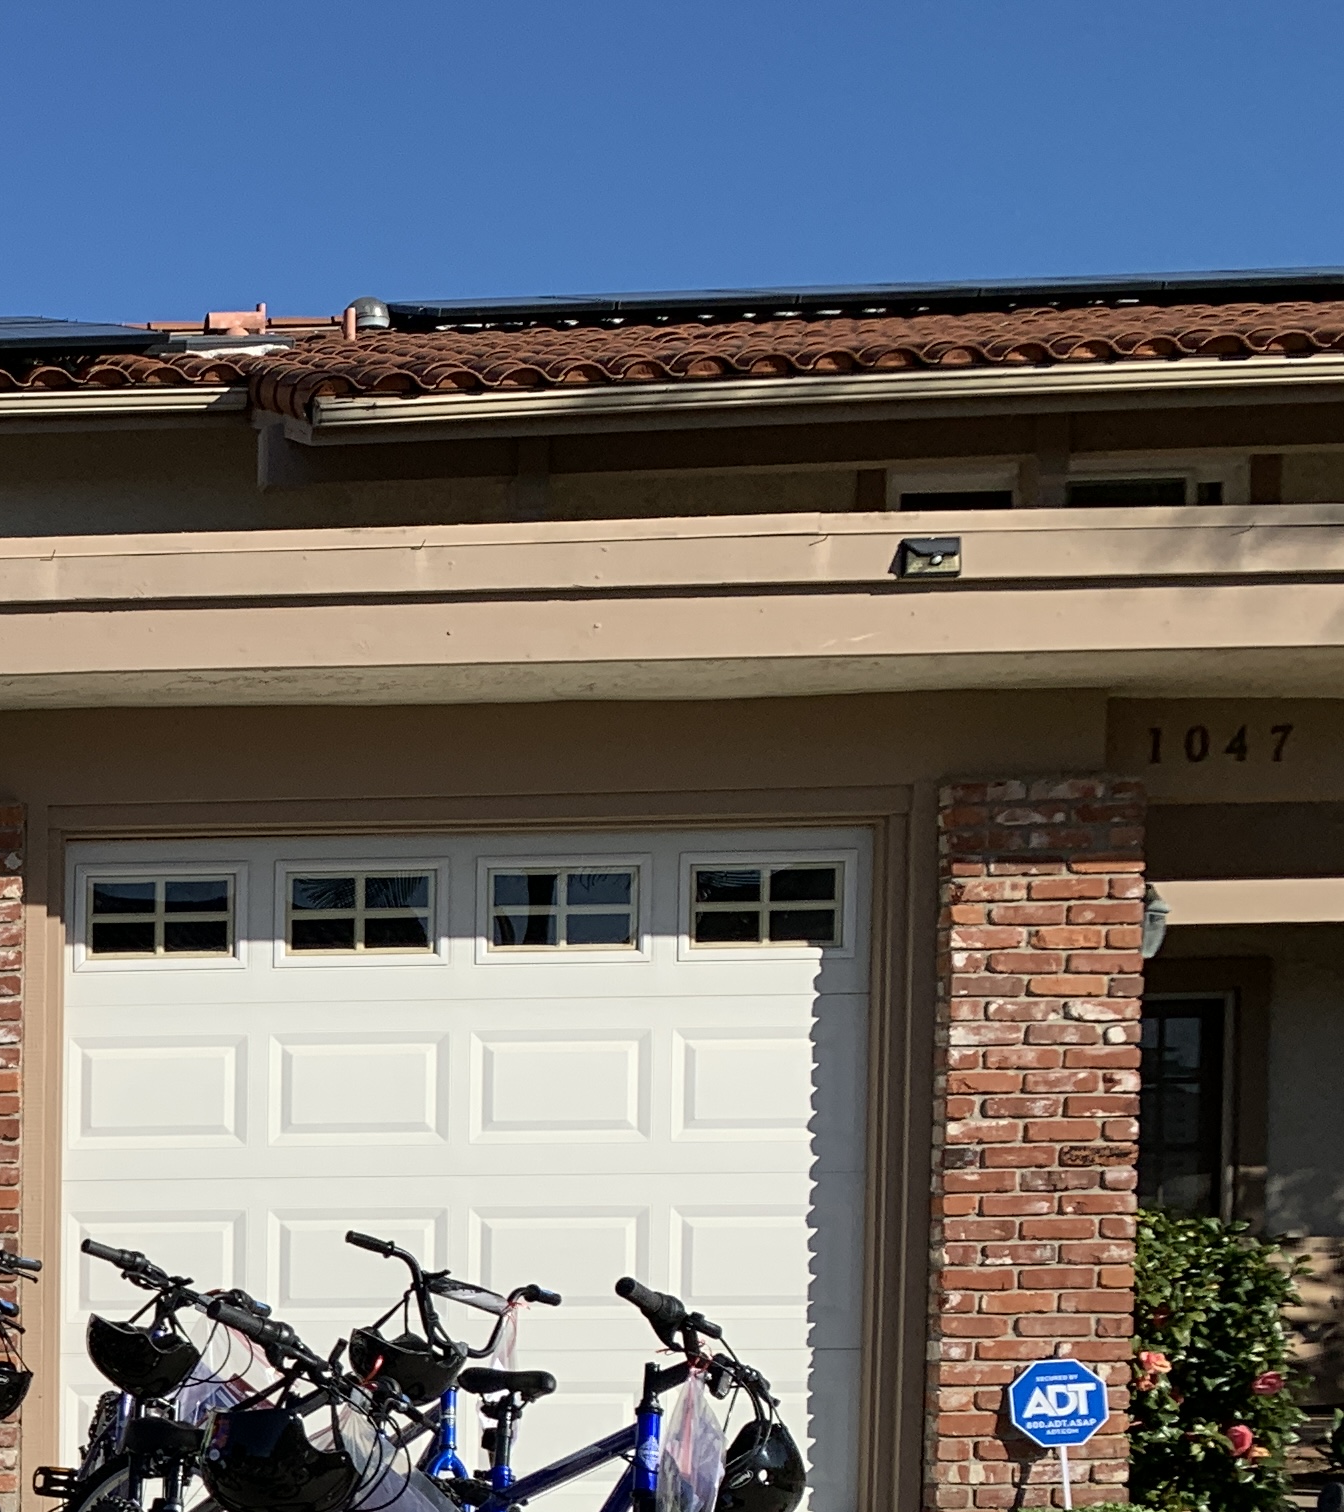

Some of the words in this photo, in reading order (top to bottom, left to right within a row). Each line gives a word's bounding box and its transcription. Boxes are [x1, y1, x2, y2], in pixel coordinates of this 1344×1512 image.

[1148, 723, 1294, 764] 1047
[1022, 1382, 1097, 1418] ADT
[1026, 1418, 1097, 1429] 800.ADT.ASAP
